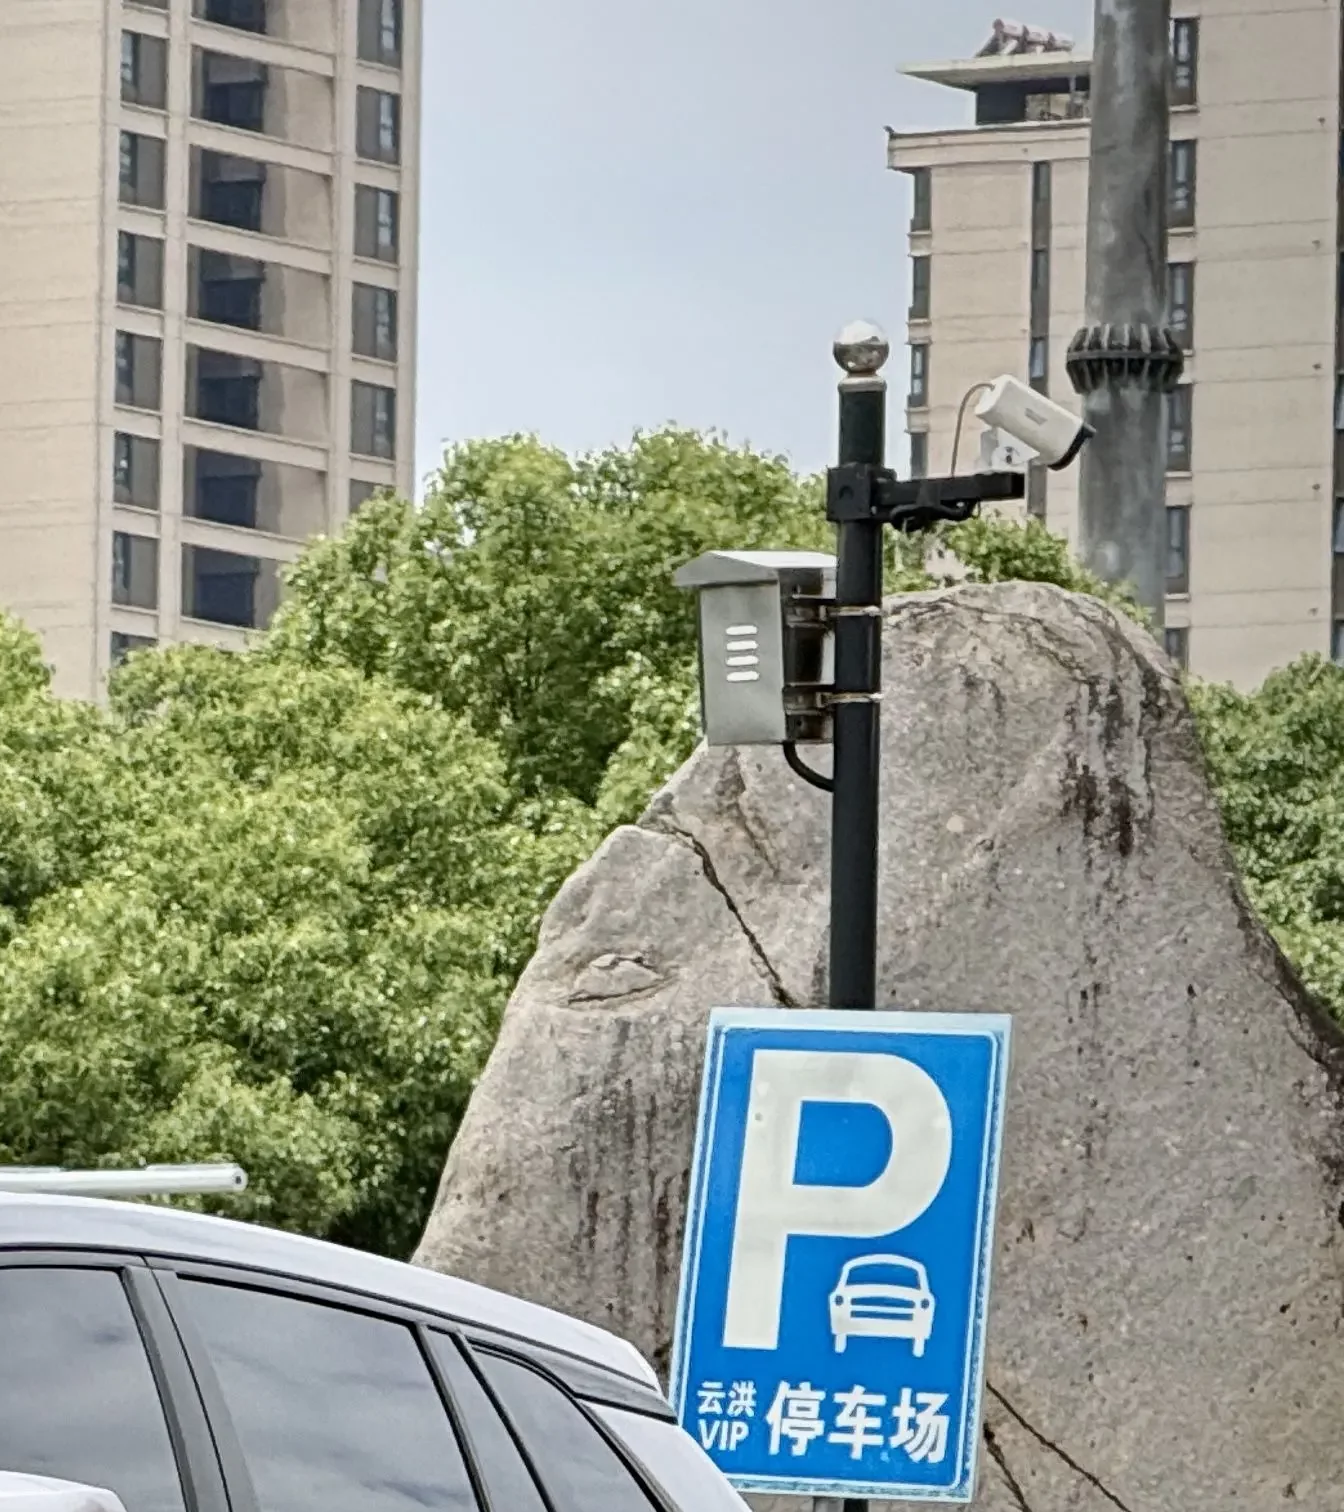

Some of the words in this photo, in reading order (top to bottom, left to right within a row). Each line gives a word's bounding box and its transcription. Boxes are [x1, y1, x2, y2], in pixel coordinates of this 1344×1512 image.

[723, 1049, 952, 1349] P
[697, 1420, 749, 1452] VIP
[766, 1381, 949, 1465] 停车场
